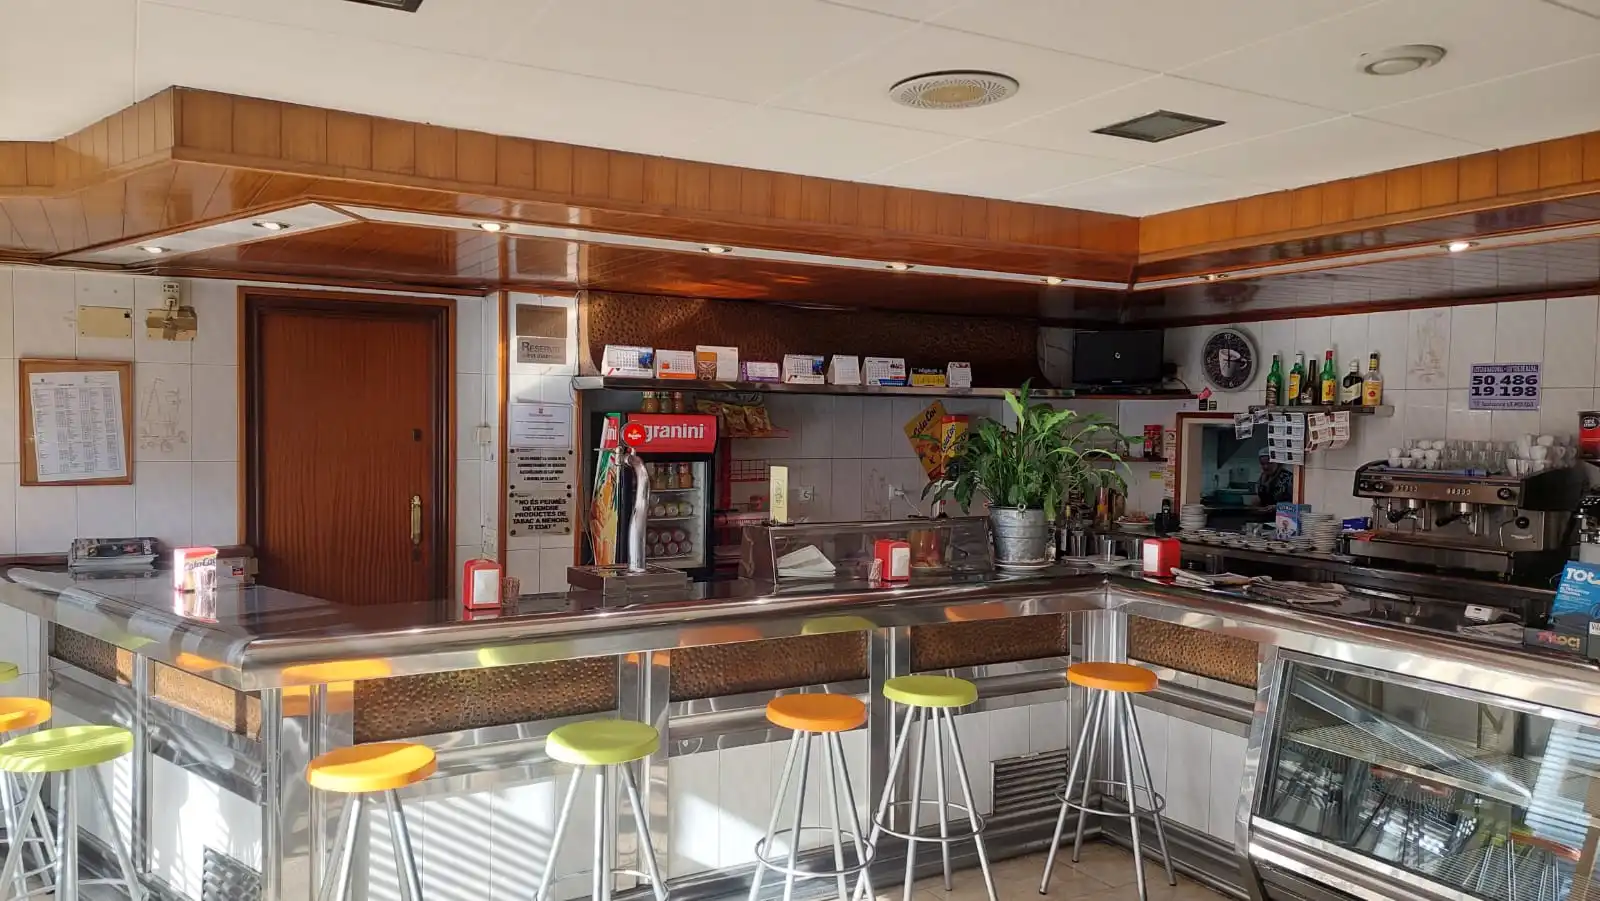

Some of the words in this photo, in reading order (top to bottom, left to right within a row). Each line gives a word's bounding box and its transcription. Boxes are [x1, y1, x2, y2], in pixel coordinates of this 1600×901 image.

[1472, 374, 1538, 386] 50.486
[1471, 386, 1537, 397] 19.198
[644, 423, 705, 443] granini
